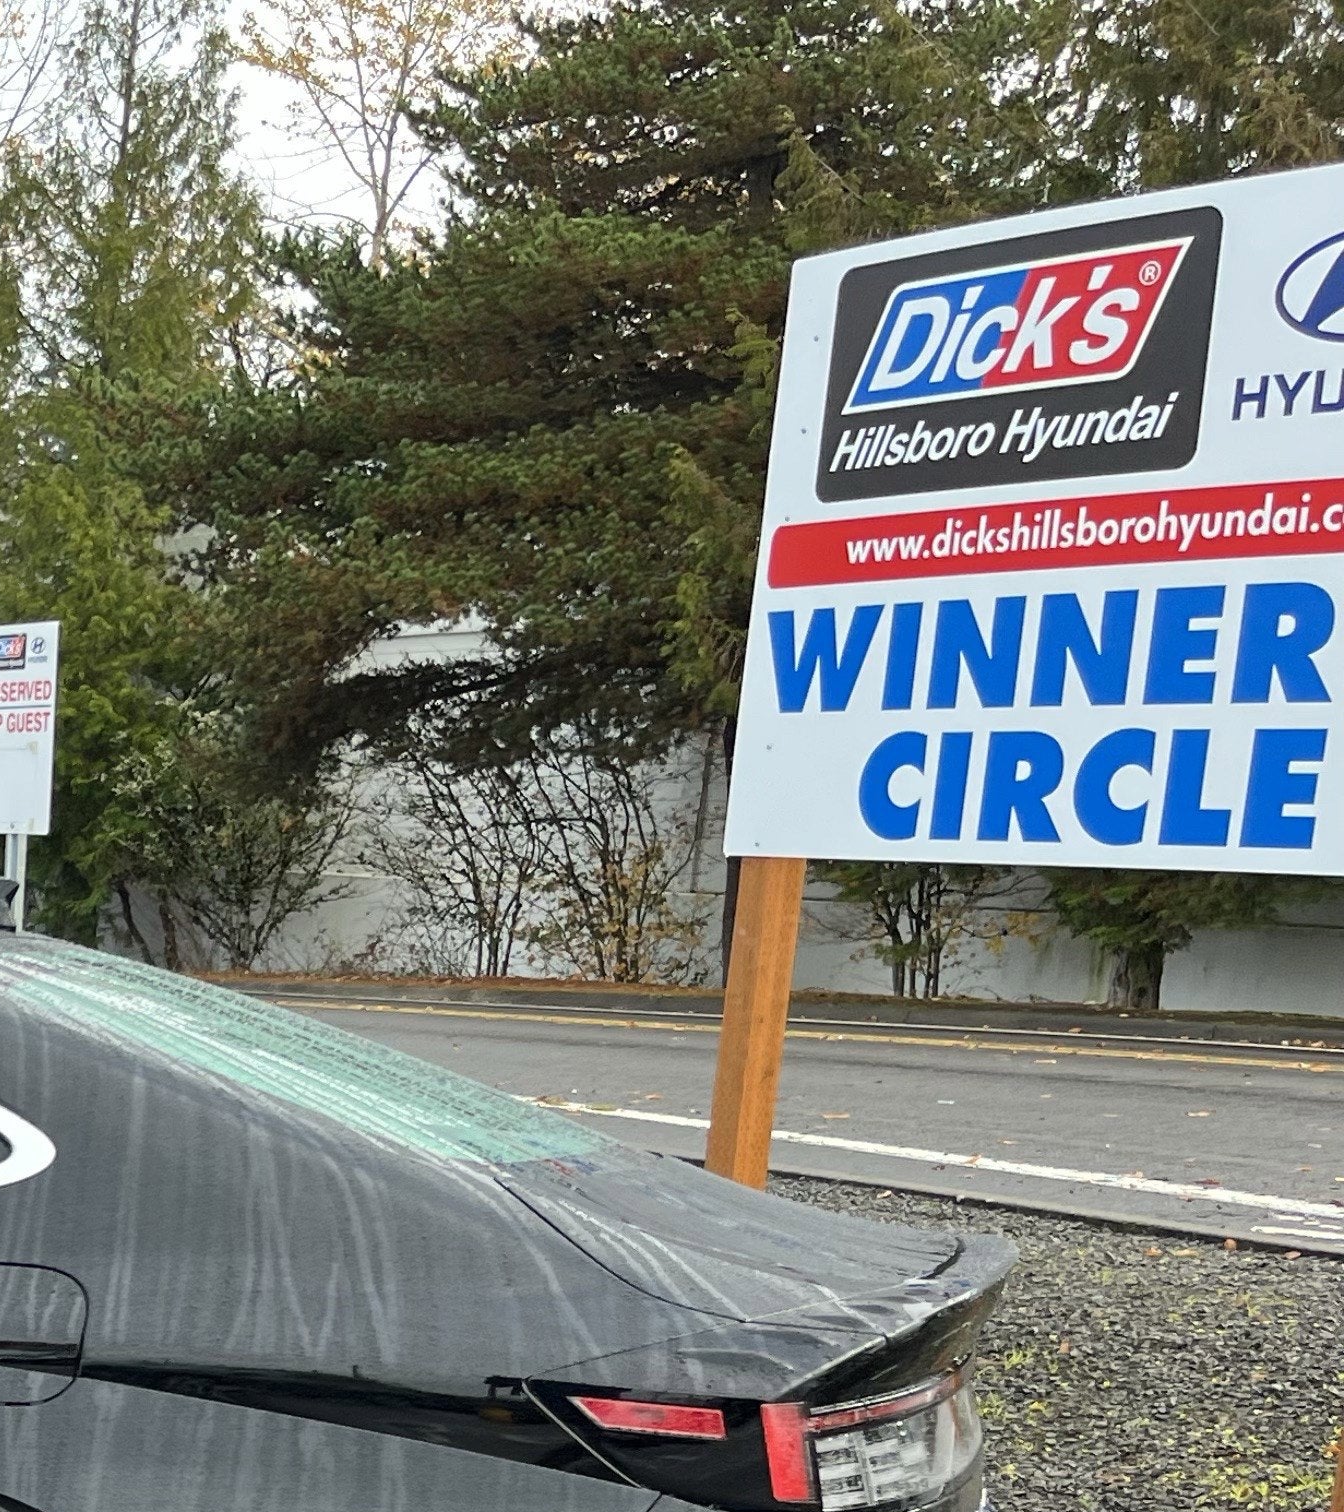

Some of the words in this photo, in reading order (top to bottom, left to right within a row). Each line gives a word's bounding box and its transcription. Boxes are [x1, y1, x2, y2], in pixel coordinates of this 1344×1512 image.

[867, 265, 1140, 393] Dick's
[829, 420, 997, 473] Hillsboro
[998, 391, 1180, 464] Hyundai
[846, 490, 1344, 565] www.dickshillsborohyundai.c
[767, 582, 1336, 714] WINNER
[6, 711, 50, 733] GUEST
[858, 728, 1329, 850] CIRCLE
